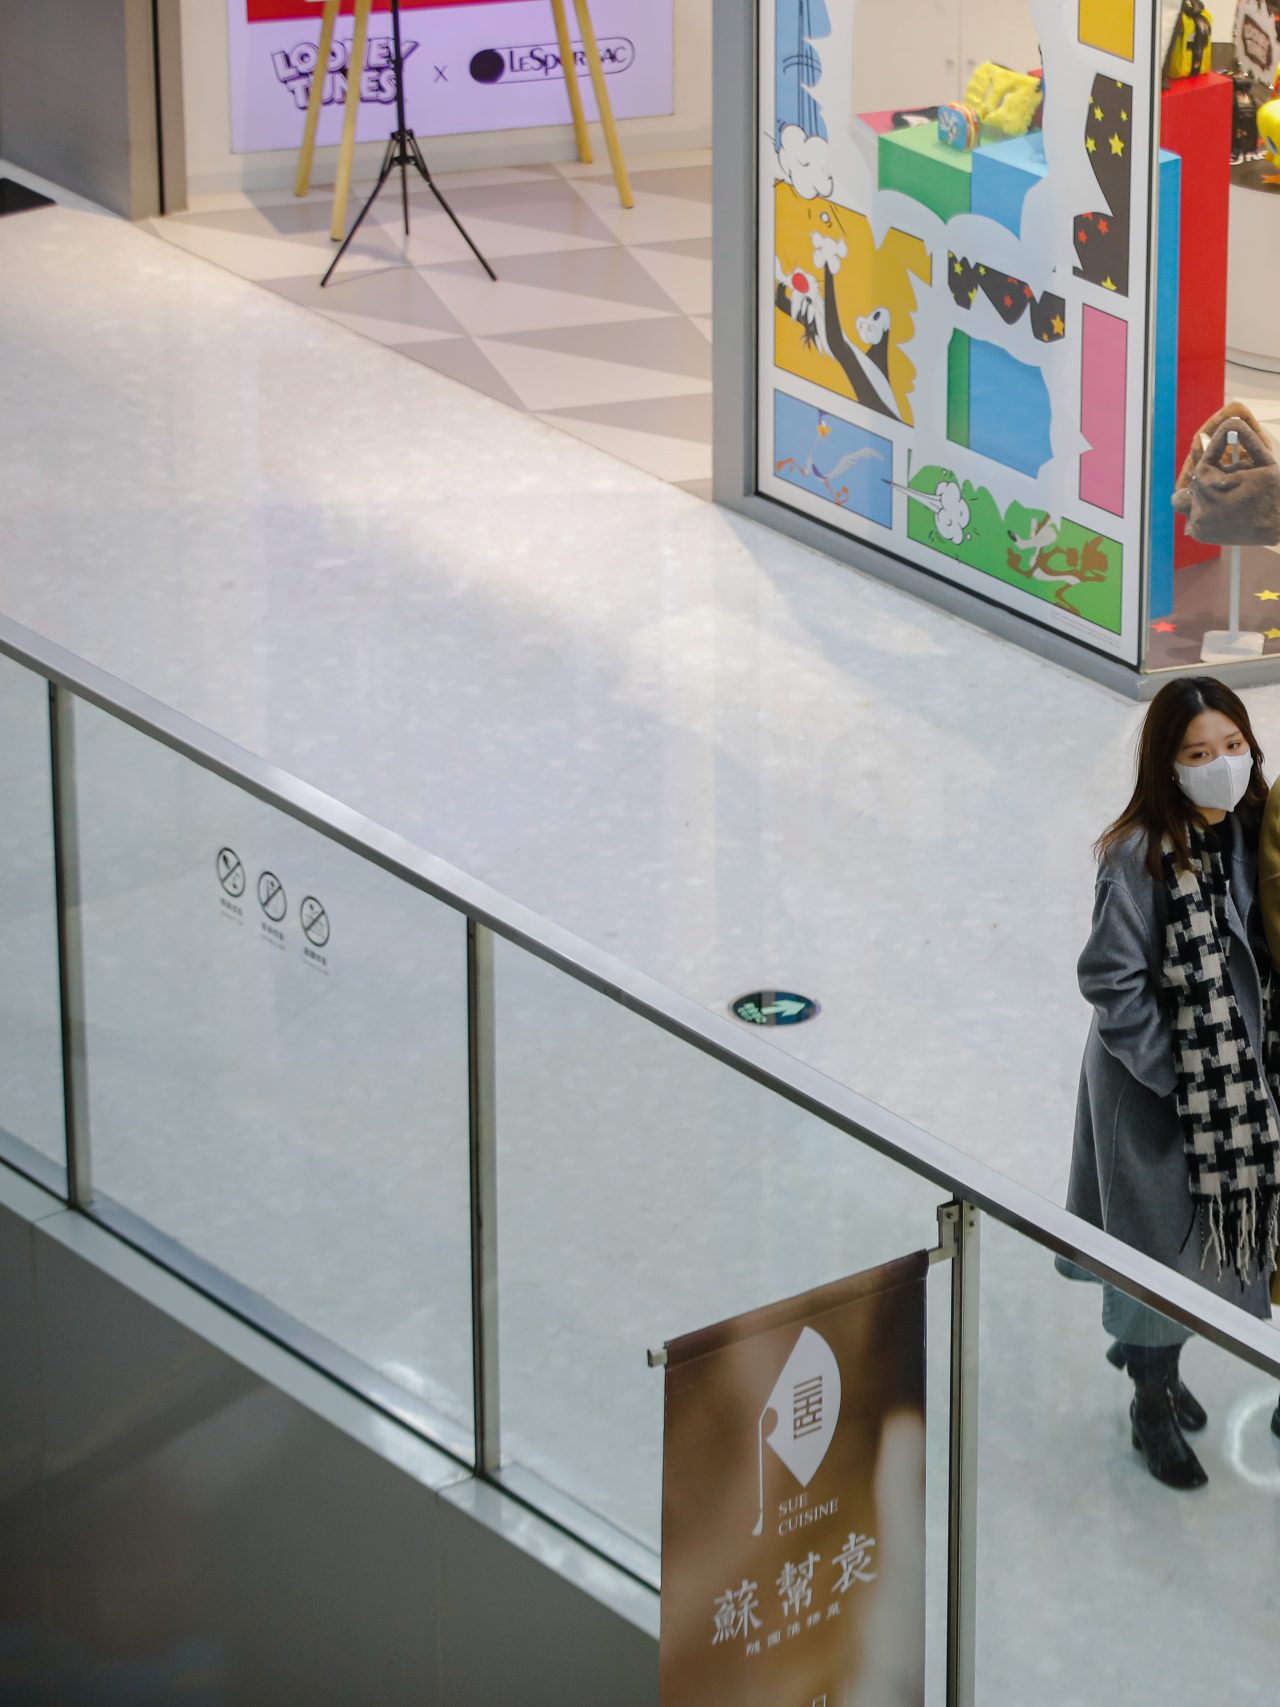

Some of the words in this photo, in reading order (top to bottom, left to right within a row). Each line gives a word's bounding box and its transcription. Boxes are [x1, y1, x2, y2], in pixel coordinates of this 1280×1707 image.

[778, 1492, 808, 1516] SUE
[778, 1497, 839, 1536] CUISINE
[711, 1531, 878, 1646] 蘇幫袁
